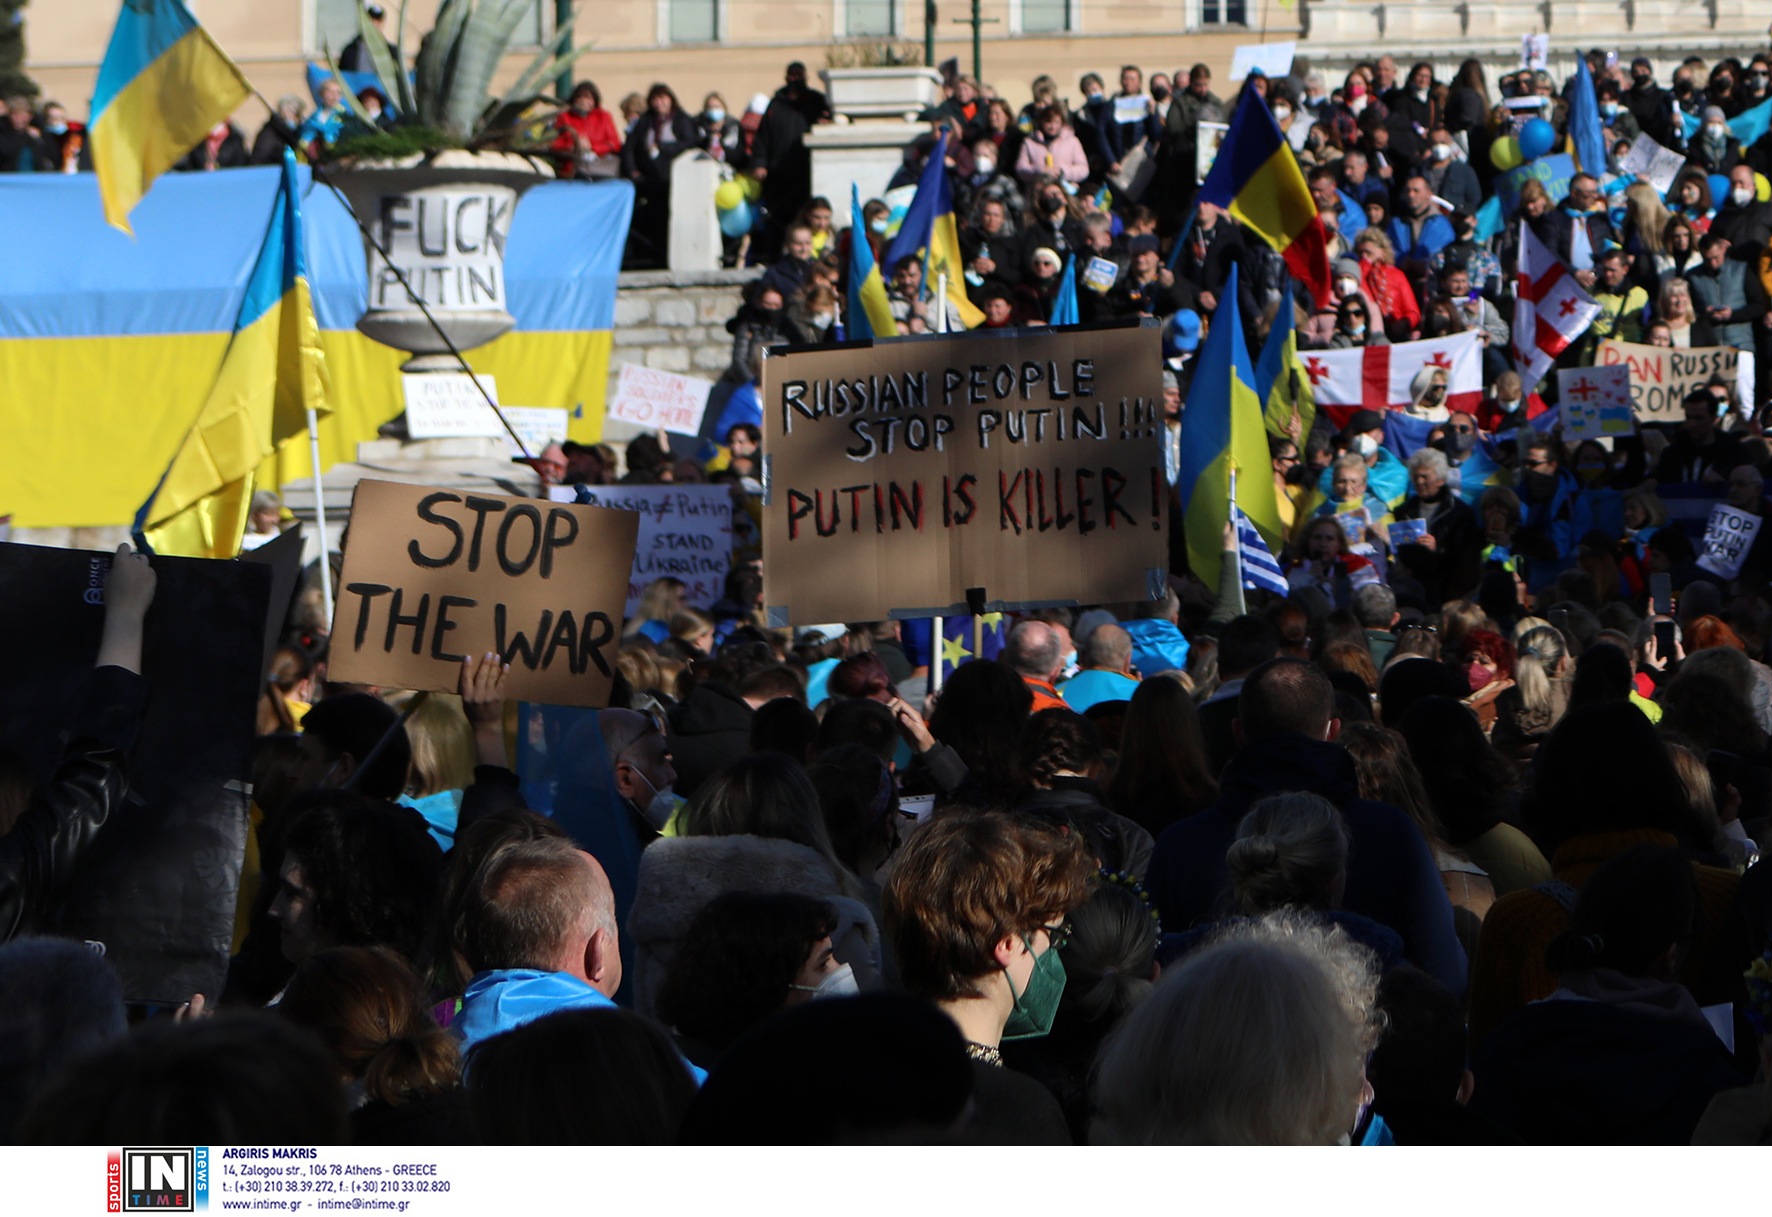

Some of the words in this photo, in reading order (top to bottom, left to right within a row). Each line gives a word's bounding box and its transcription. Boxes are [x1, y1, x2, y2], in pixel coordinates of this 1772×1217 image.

[380, 195, 510, 262] FUCK
[378, 265, 497, 305] PUTIN
[781, 370, 929, 435] RUSSIAN
[942, 358, 1096, 407] PEOPLE
[845, 413, 955, 463] STOP
[977, 401, 1108, 451] PUTIN
[408, 491, 579, 579] STOP
[787, 479, 925, 541] PUTIN
[942, 473, 979, 530] IS
[998, 466, 1139, 536] KILLER
[1710, 510, 1755, 533] STOP
[89, 557, 100, 587] ONCE
[652, 534, 714, 550] STAND
[346, 583, 479, 663] THE
[494, 603, 617, 678] WAR
